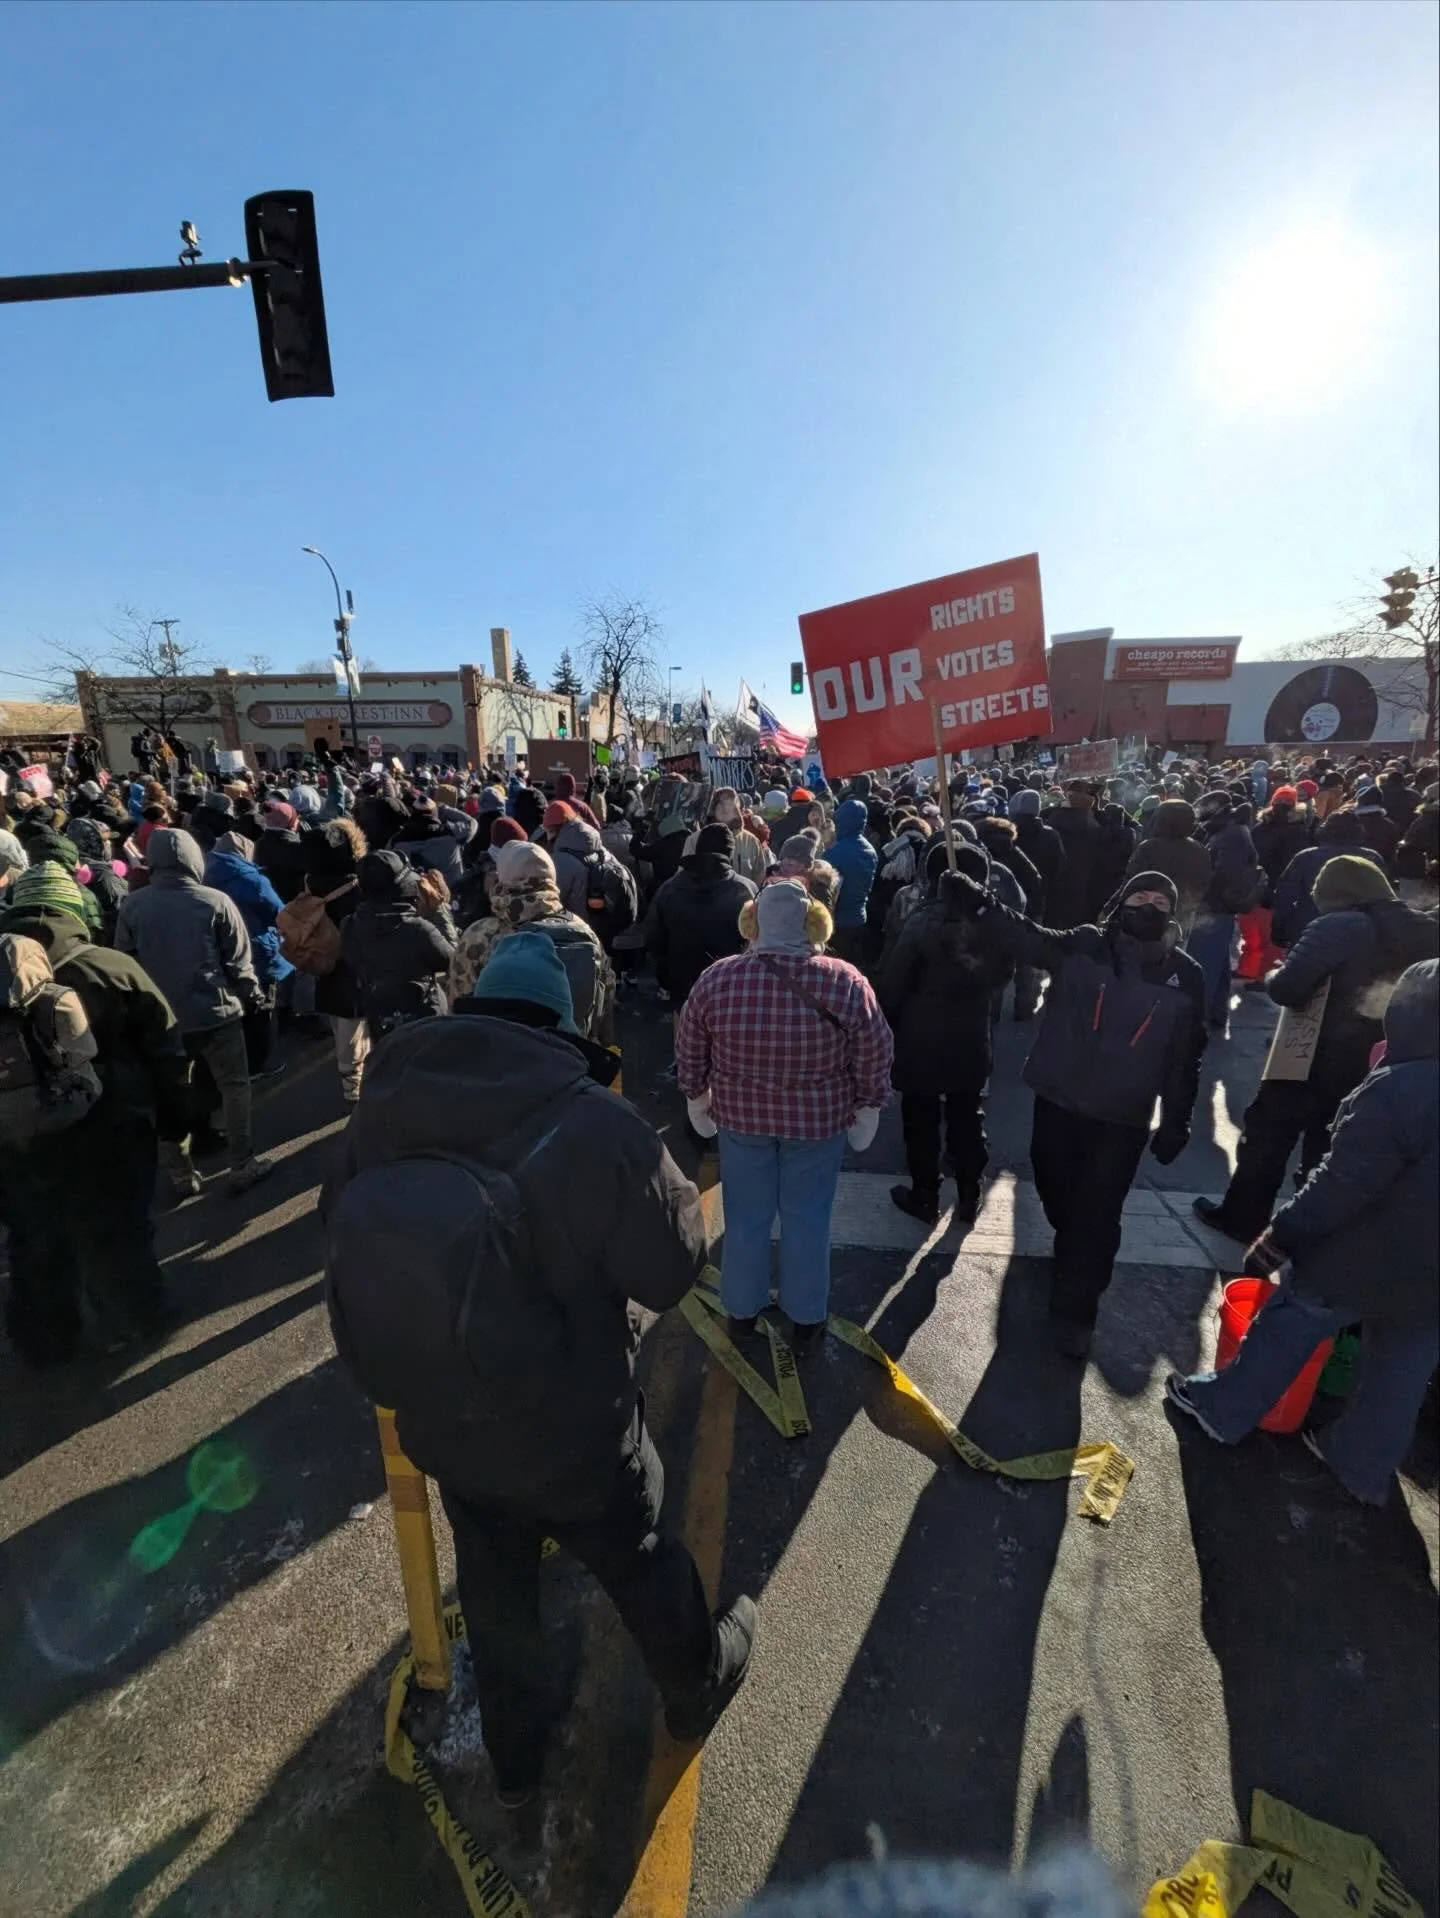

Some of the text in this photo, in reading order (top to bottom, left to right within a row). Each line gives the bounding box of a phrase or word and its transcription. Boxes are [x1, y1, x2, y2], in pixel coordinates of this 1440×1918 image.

[930, 586, 1015, 631] RIGHTS
[936, 640, 1014, 680] VOTES
[1128, 648, 1227, 661] cheapo records
[813, 647, 924, 721] OUR
[393, 706, 424, 720] INN
[941, 683, 1049, 729] STREETS
